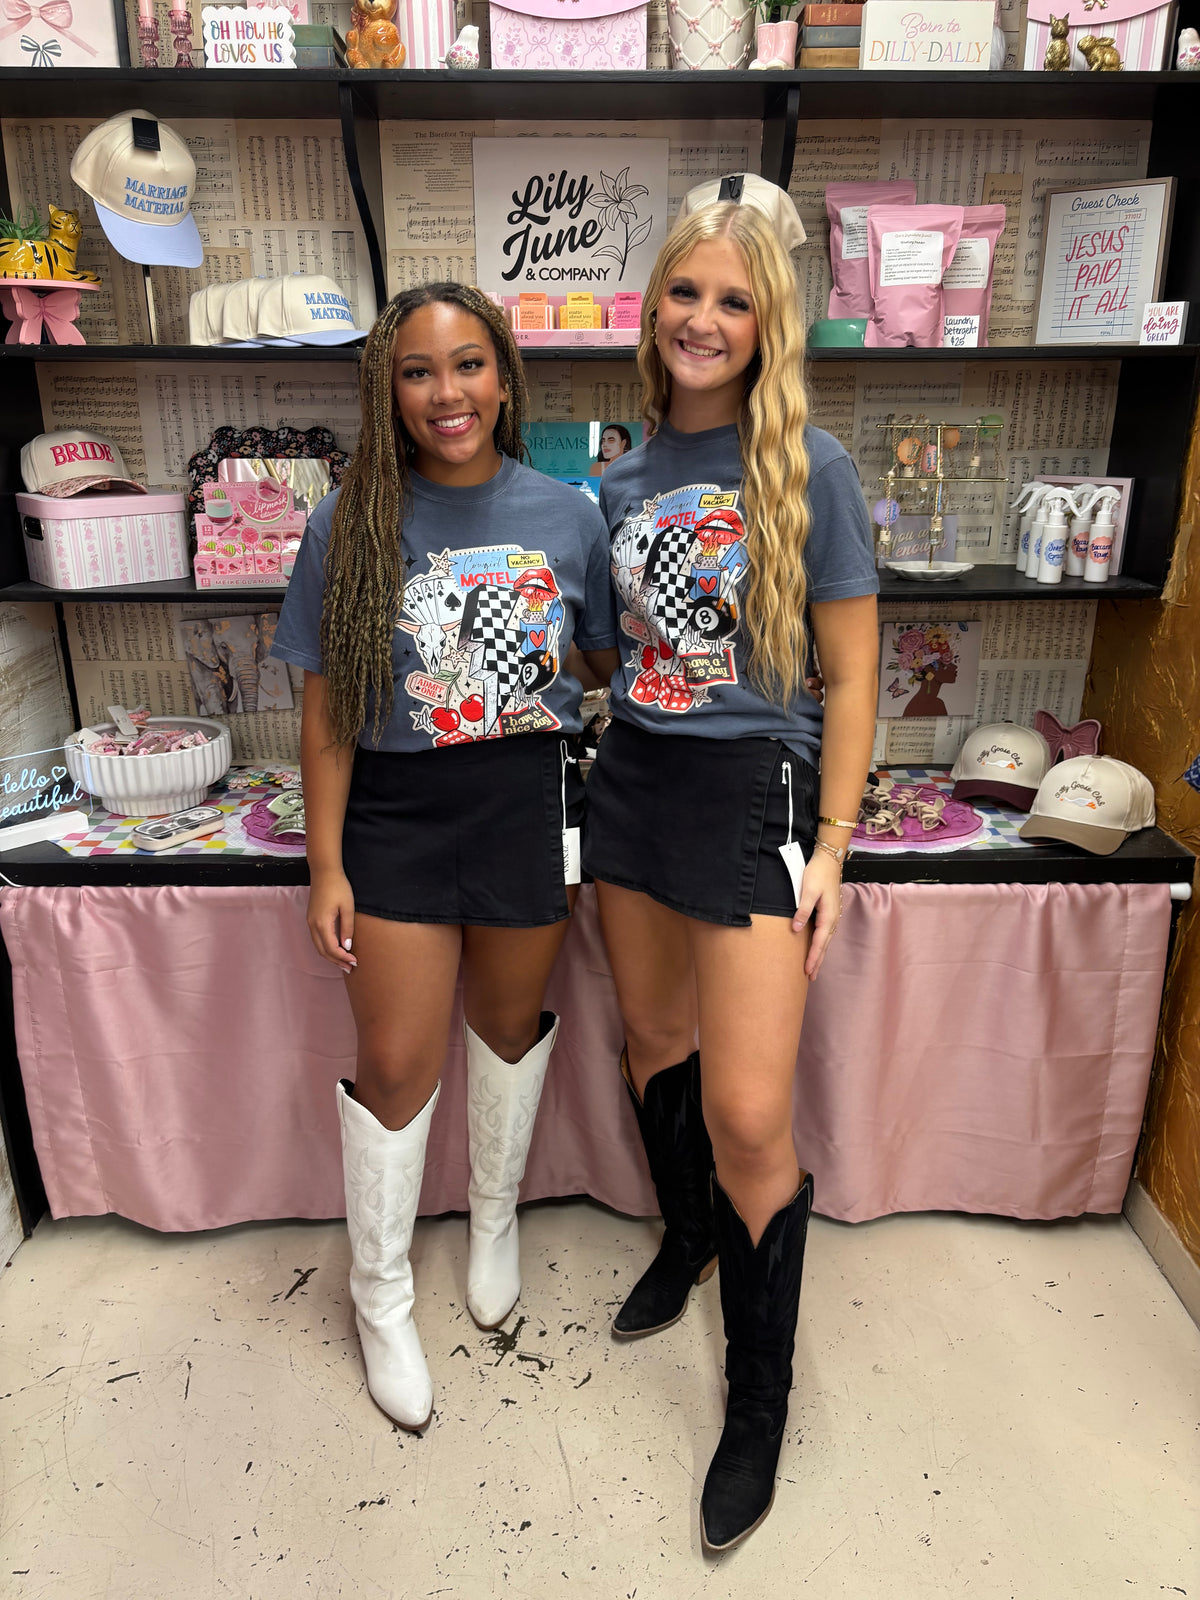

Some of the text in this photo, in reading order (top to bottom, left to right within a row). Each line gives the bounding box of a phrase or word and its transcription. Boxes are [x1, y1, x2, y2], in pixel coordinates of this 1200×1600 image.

[210, 20, 230, 40] OH
[236, 20, 265, 40] HOW
[901, 12, 961, 39] Born to
[264, 43, 282, 63] US
[869, 40, 989, 63] DILLY-DALLY
[125, 177, 188, 199] MARRIAGE
[507, 169, 594, 225] Lily
[124, 193, 184, 215] MATERIAL
[1072, 193, 1139, 212] Guest Check
[501, 219, 603, 281] June
[1066, 225, 1129, 262] JESUS
[525, 267, 611, 281] & COMPANY
[1074, 258, 1121, 291] PAID
[1068, 286, 1129, 321] IT ALL
[1148, 305, 1179, 317] YOU ARE
[945, 316, 973, 326] Laundry
[1143, 316, 1180, 335] doing
[944, 326, 978, 339] Detergent
[950, 336, 965, 347] $25
[1147, 332, 1169, 342] GREAT
[50, 441, 115, 466] BRIDE
[655, 511, 698, 529] MOTEL
[437, 581, 444, 590] A
[461, 571, 514, 587] MOTEL
[700, 610, 712, 625] 8
[708, 665, 730, 678] day
[713, 658, 721, 667] a
[525, 665, 533, 680] 8
[418, 679, 445, 692] ADMIT
[421, 687, 436, 698] ONE
[505, 716, 554, 735] nice day
[509, 714, 533, 726] have
[1070, 781, 1092, 793] Goose
[0, 780, 84, 818] eautiful
